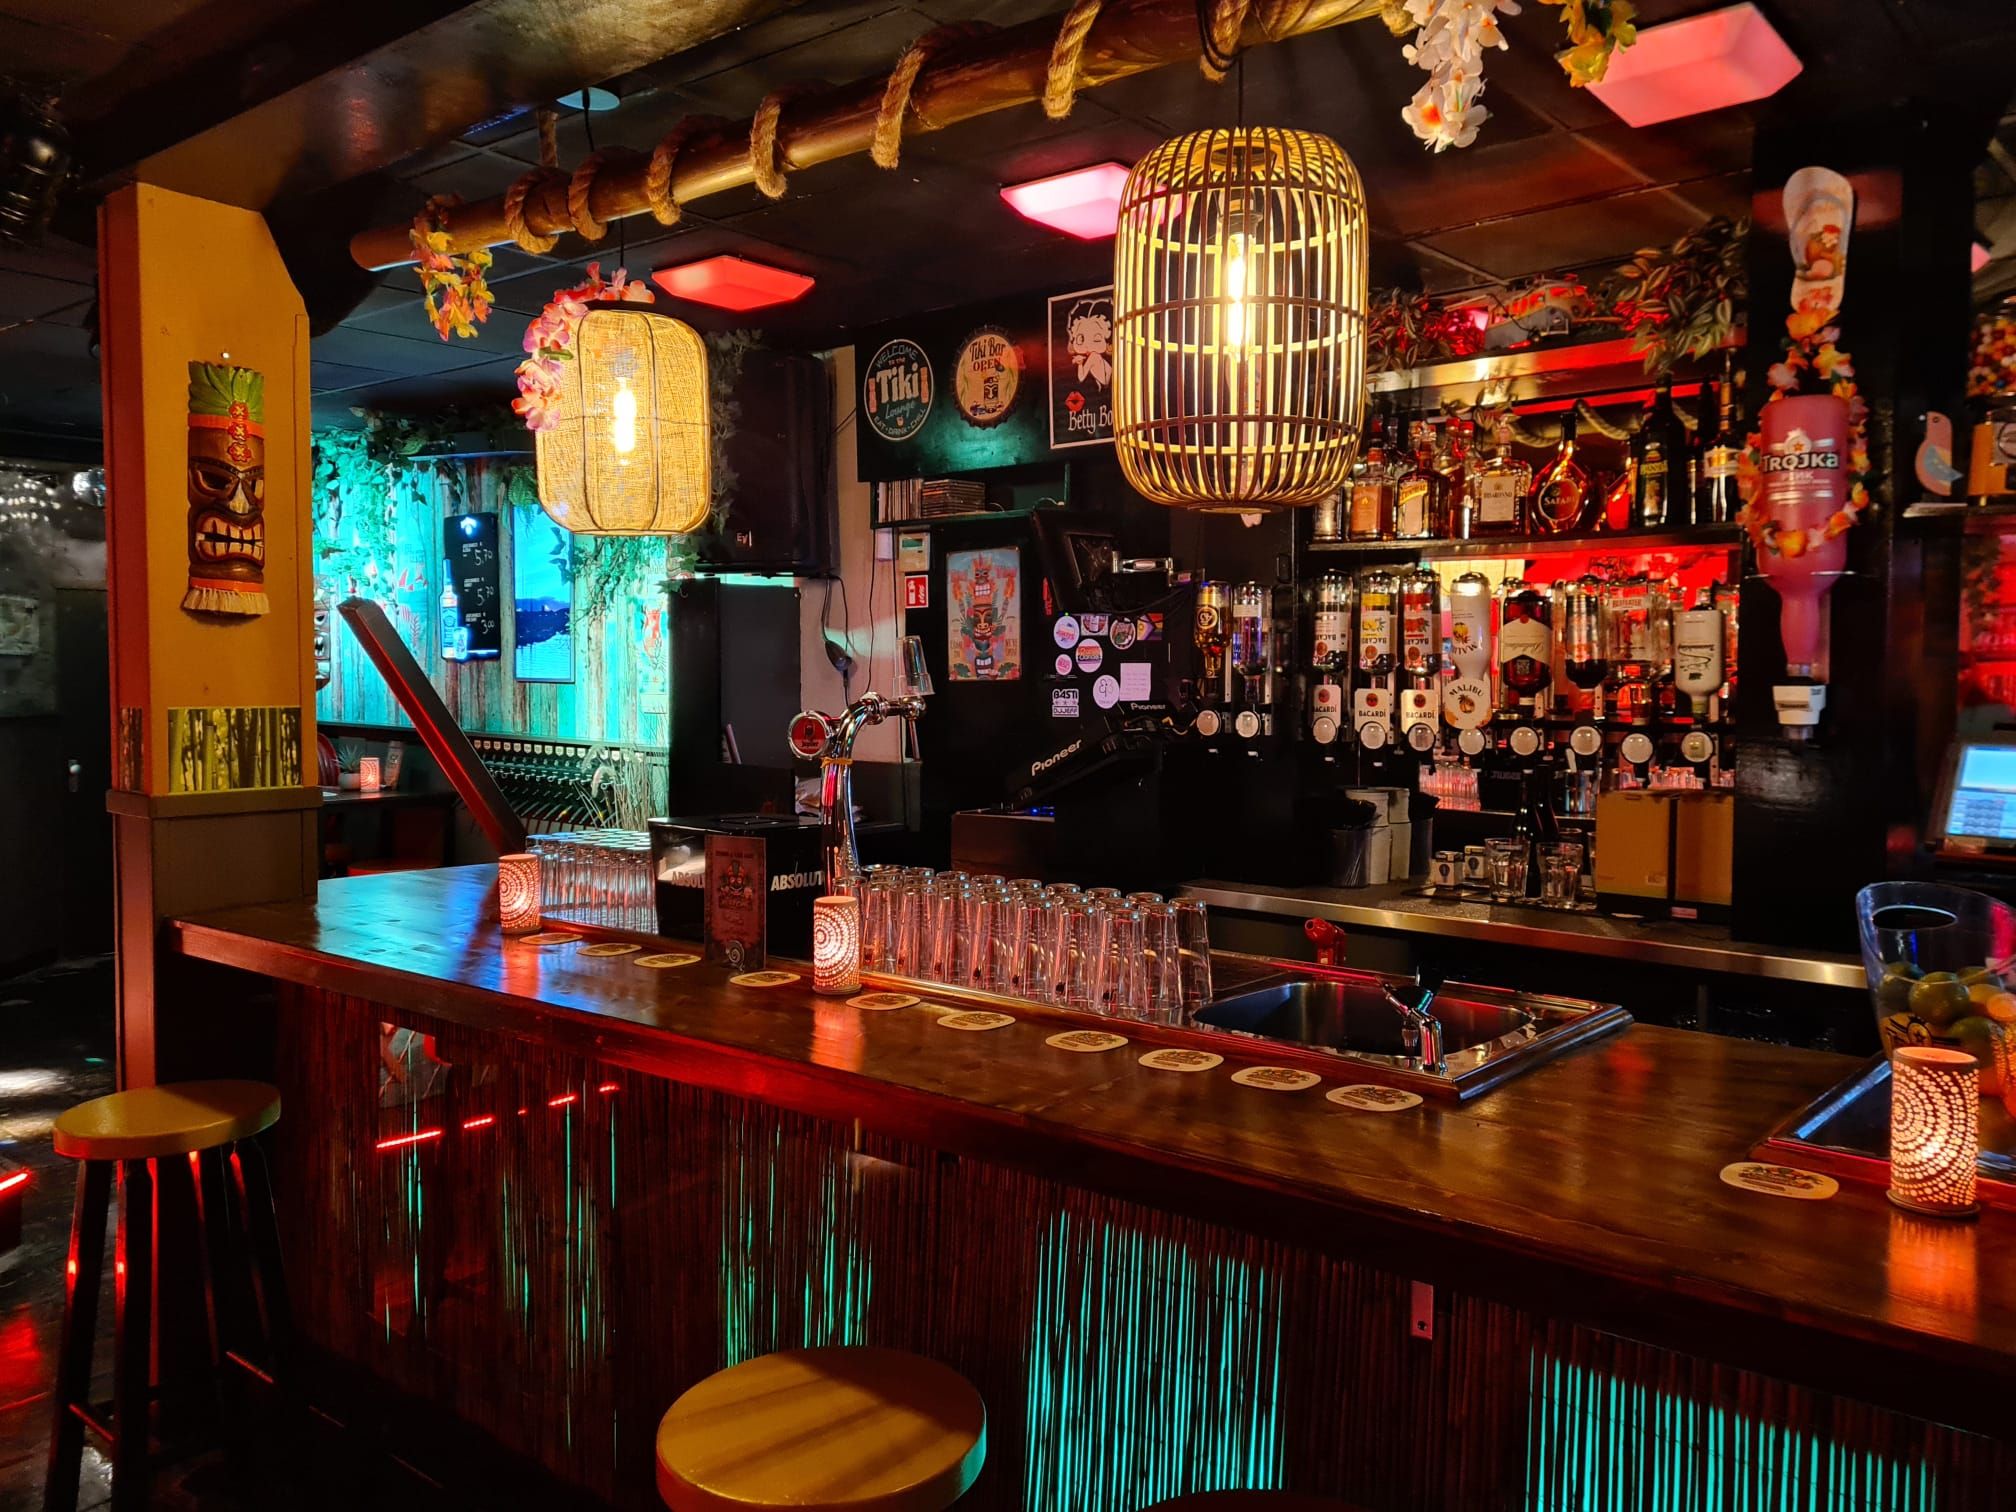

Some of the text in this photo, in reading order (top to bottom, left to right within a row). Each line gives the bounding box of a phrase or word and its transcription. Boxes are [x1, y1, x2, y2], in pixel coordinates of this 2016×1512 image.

[876, 345, 918, 368] WELCOME
[969, 337, 1006, 361] Tiki Bar
[973, 357, 1001, 372] OPEN
[876, 362, 919, 404] Tiki
[886, 401, 914, 420] Lounge
[1068, 404, 1113, 434] Betty Bo
[1449, 683, 1484, 697] MALIBU
[1130, 702, 1166, 711] Pioneer
[1031, 739, 1082, 777] Pioneer
[671, 871, 706, 889] ABSOL
[770, 870, 823, 891] ABSOLUT
